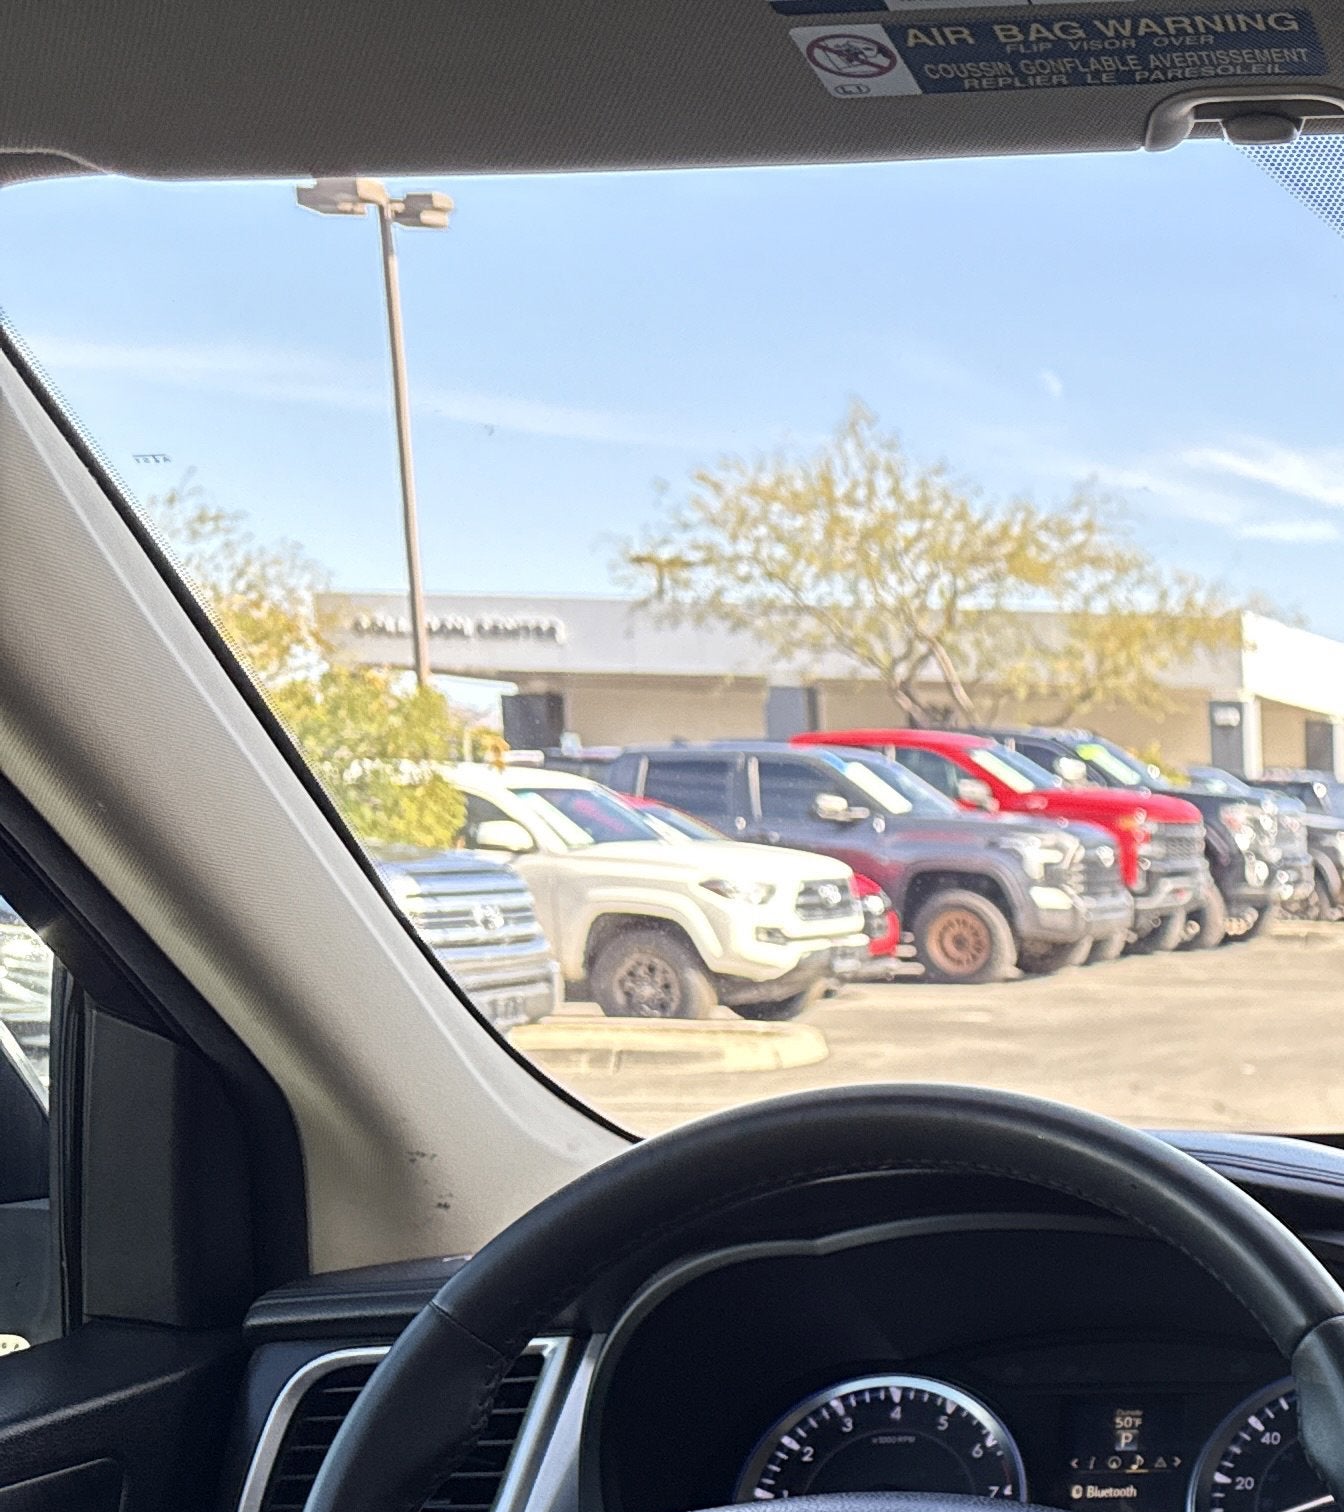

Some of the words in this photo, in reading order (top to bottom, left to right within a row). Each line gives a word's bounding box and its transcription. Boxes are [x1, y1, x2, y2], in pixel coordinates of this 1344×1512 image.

[906, 25, 976, 48] AIR
[993, 20, 1086, 44] BAG
[1093, 11, 1299, 38] WARNING
[1006, 42, 1052, 55] FLIP
[1068, 38, 1137, 51] VISOR
[1153, 34, 1215, 47] OVER
[924, 60, 1013, 80] COUSSIN
[1020, 55, 1144, 75] GONFLABLE
[1150, 48, 1309, 69] AVERTISSEMENT
[964, 74, 1067, 91] REPLIER
[1087, 72, 1117, 84] LE
[1135, 63, 1287, 83] PARESOLEIL
[890, 1406, 901, 1421] 4
[842, 1418, 853, 1433] 3
[937, 1415, 949, 1431] 5
[1120, 1433, 1133, 1448] P
[1261, 1432, 1280, 1445] 40
[802, 1447, 814, 1462] 2
[972, 1444, 983, 1458] 6
[1235, 1477, 1254, 1490] 20
[989, 1486, 999, 1499] 7
[1086, 1485, 1137, 1498] Bluetooth
